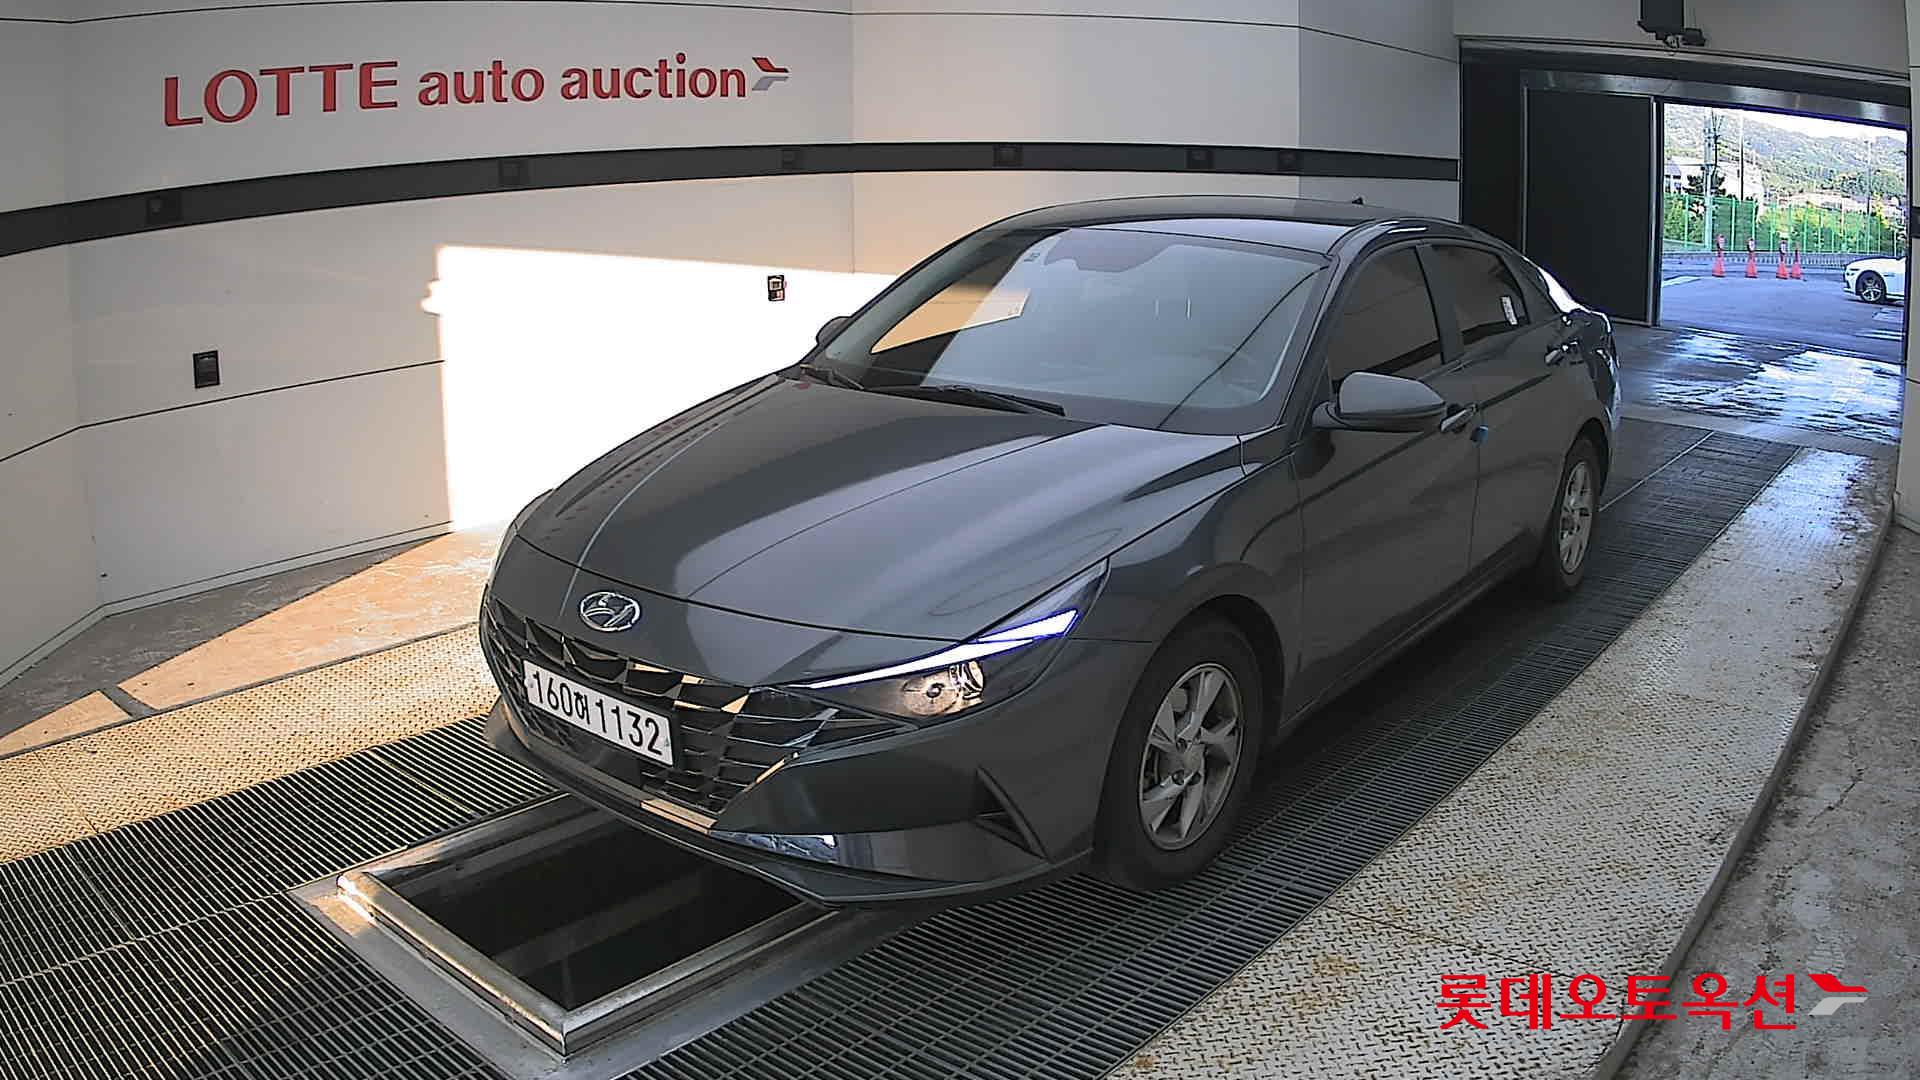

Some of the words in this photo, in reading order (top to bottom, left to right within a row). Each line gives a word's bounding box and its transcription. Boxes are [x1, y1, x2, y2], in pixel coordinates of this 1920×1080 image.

[163, 61, 398, 126] LOTTE
[418, 60, 544, 106] auto
[560, 53, 747, 100] auction
[532, 670, 662, 756] 160허1132
